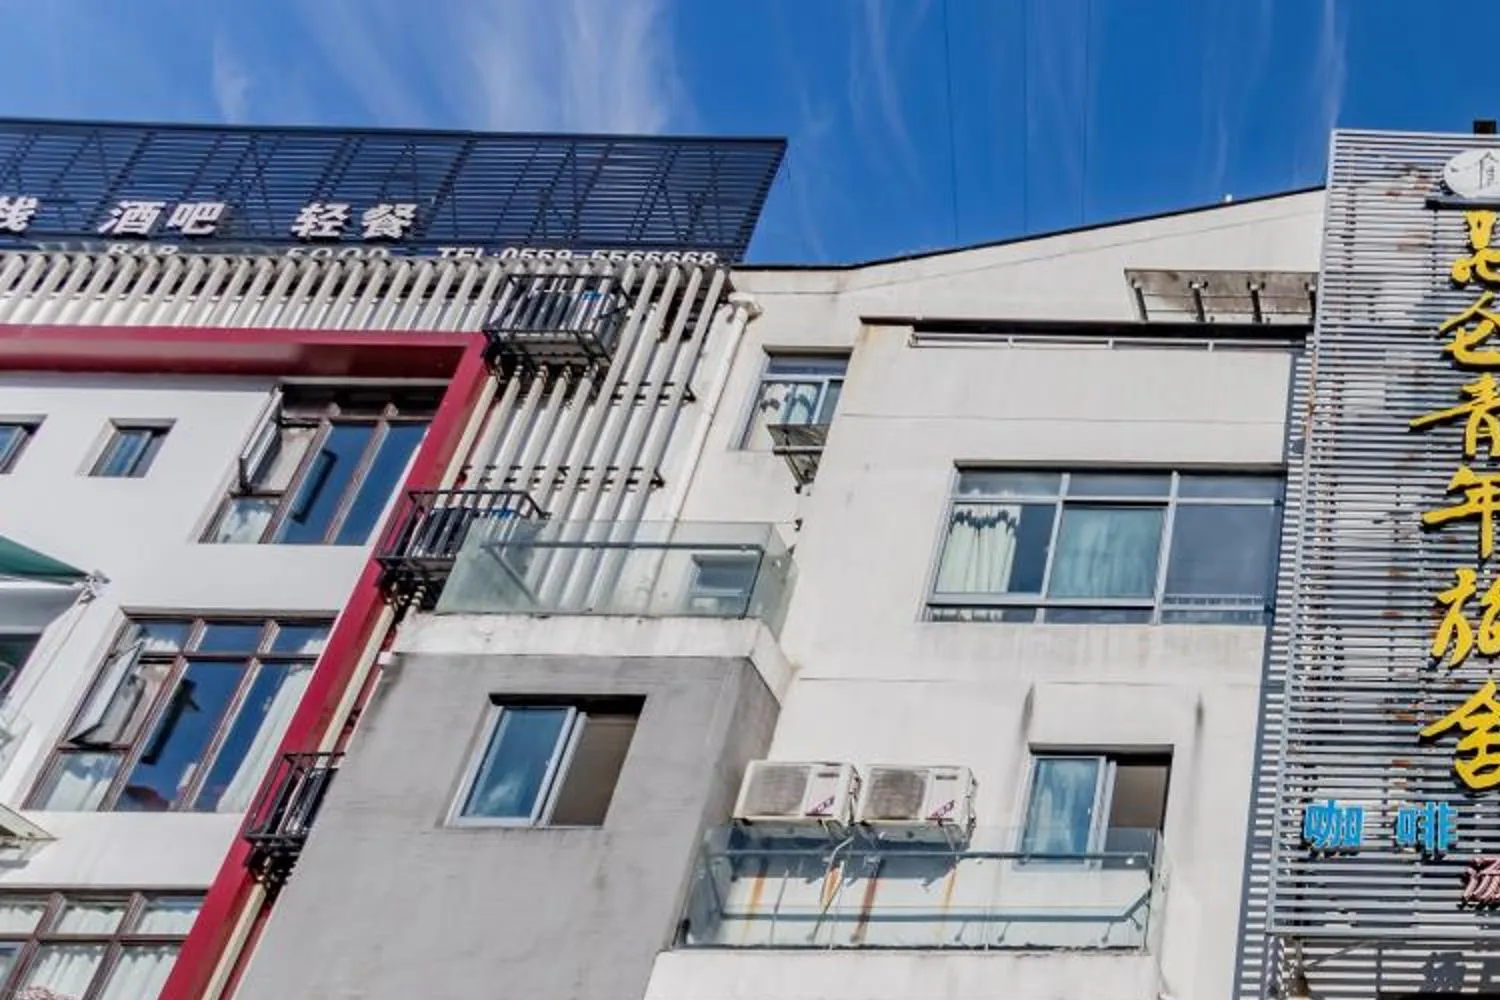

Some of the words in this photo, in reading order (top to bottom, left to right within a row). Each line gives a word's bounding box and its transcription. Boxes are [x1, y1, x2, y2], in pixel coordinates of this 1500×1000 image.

[98, 200, 225, 235] 酒吧
[290, 202, 418, 239] 轻餐
[1303, 802, 1459, 852] 咖啡
